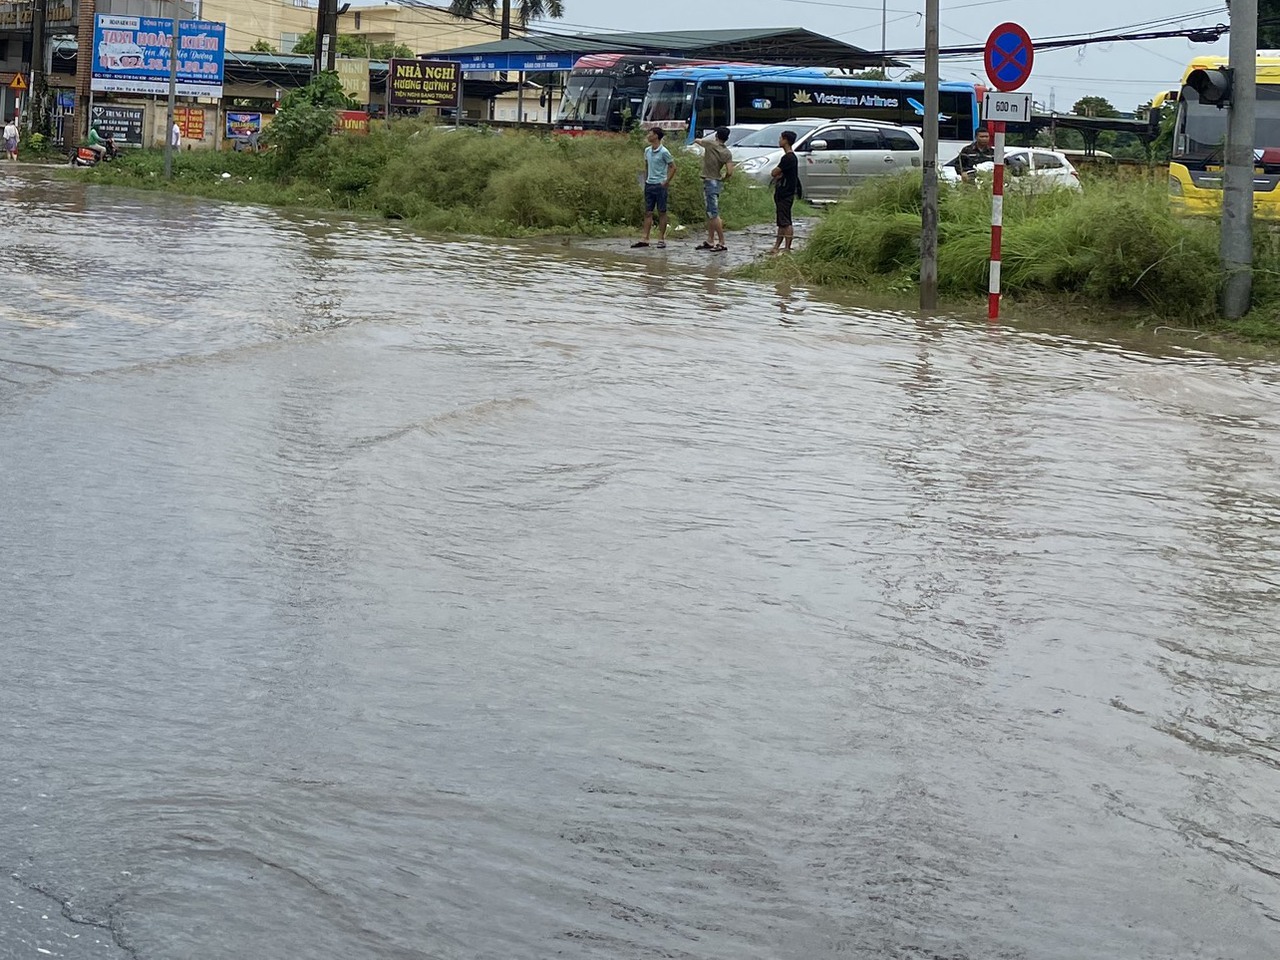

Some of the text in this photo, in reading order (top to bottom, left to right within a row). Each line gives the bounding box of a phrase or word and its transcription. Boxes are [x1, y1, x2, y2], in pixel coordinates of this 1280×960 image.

[102, 30, 134, 44] TAXI
[181, 33, 218, 50] KIẾM
[396, 63, 456, 80] NHÀ NGHỈ
[451, 82, 457, 92] 2
[814, 92, 899, 107] Vietnam Airlines
[996, 101, 1018, 113] 600 m
